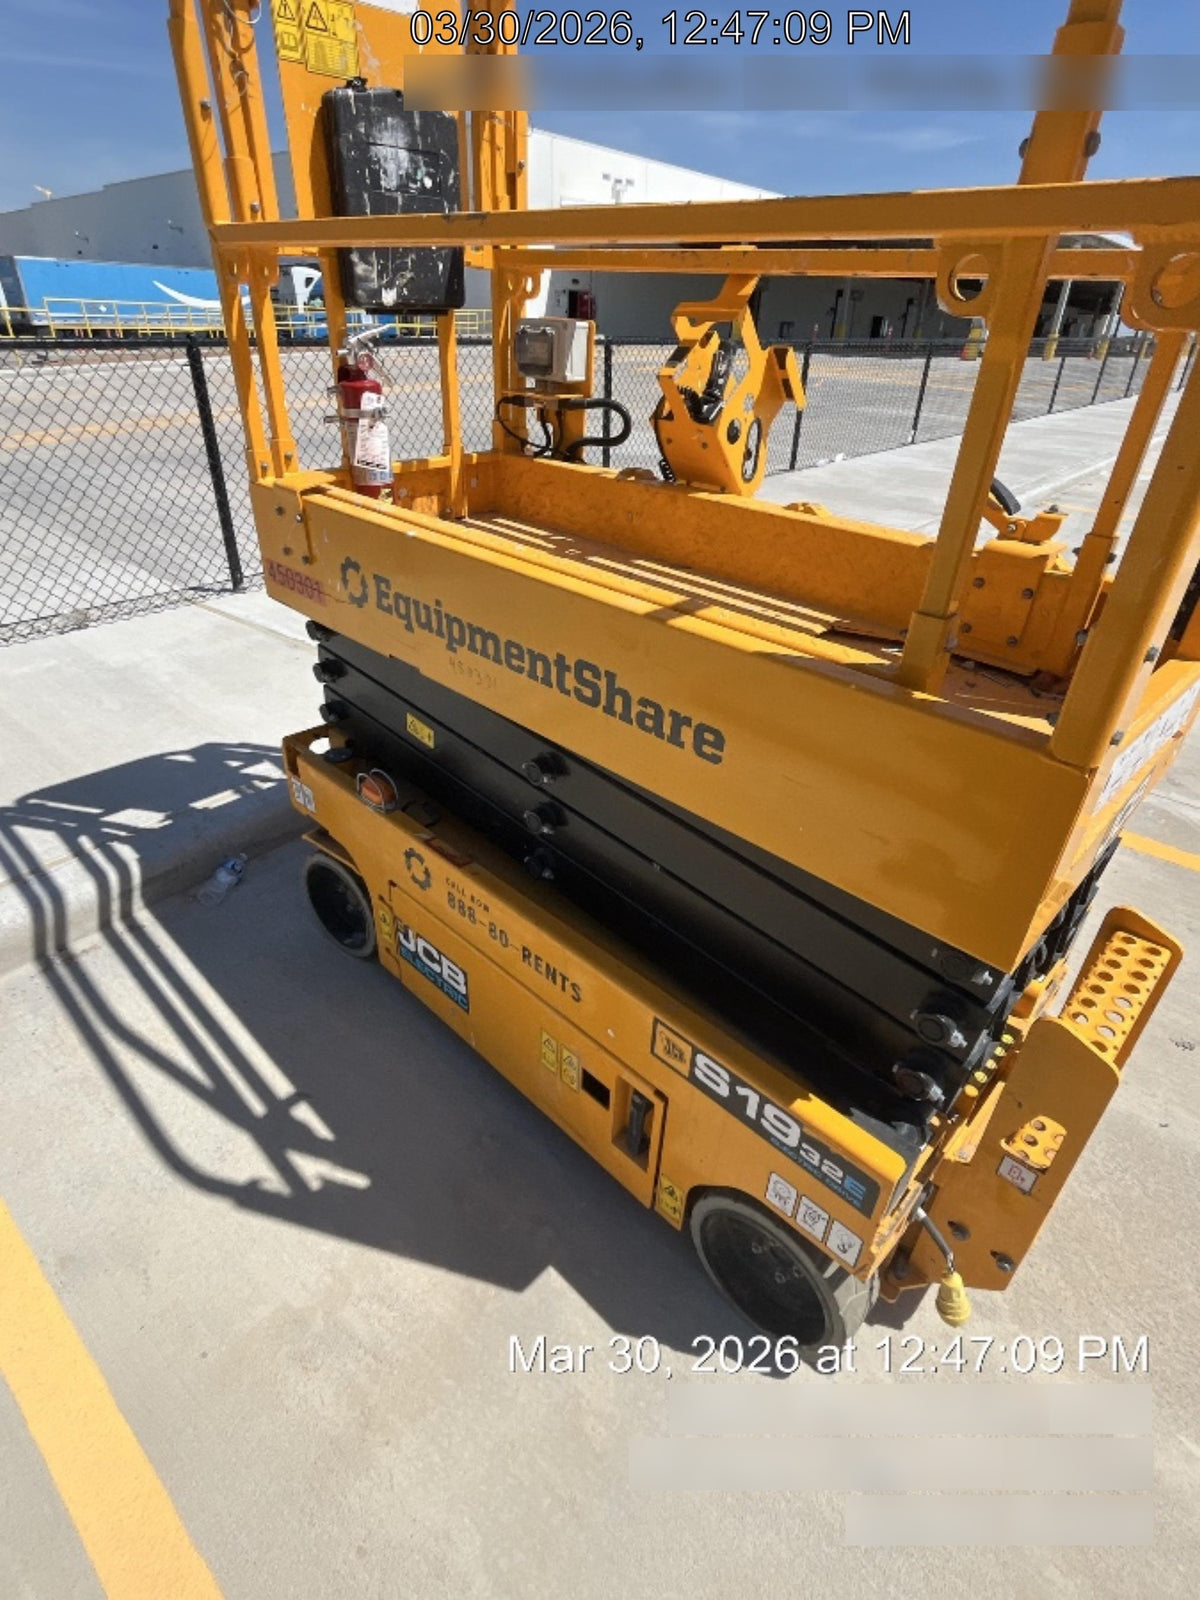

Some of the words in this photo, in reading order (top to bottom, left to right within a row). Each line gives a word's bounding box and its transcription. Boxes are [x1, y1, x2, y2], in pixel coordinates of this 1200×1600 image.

[373, 573, 726, 765] EquipmentShare
[397, 922, 468, 995] JCB
[447, 890, 583, 1003] 888-80-RENTS
